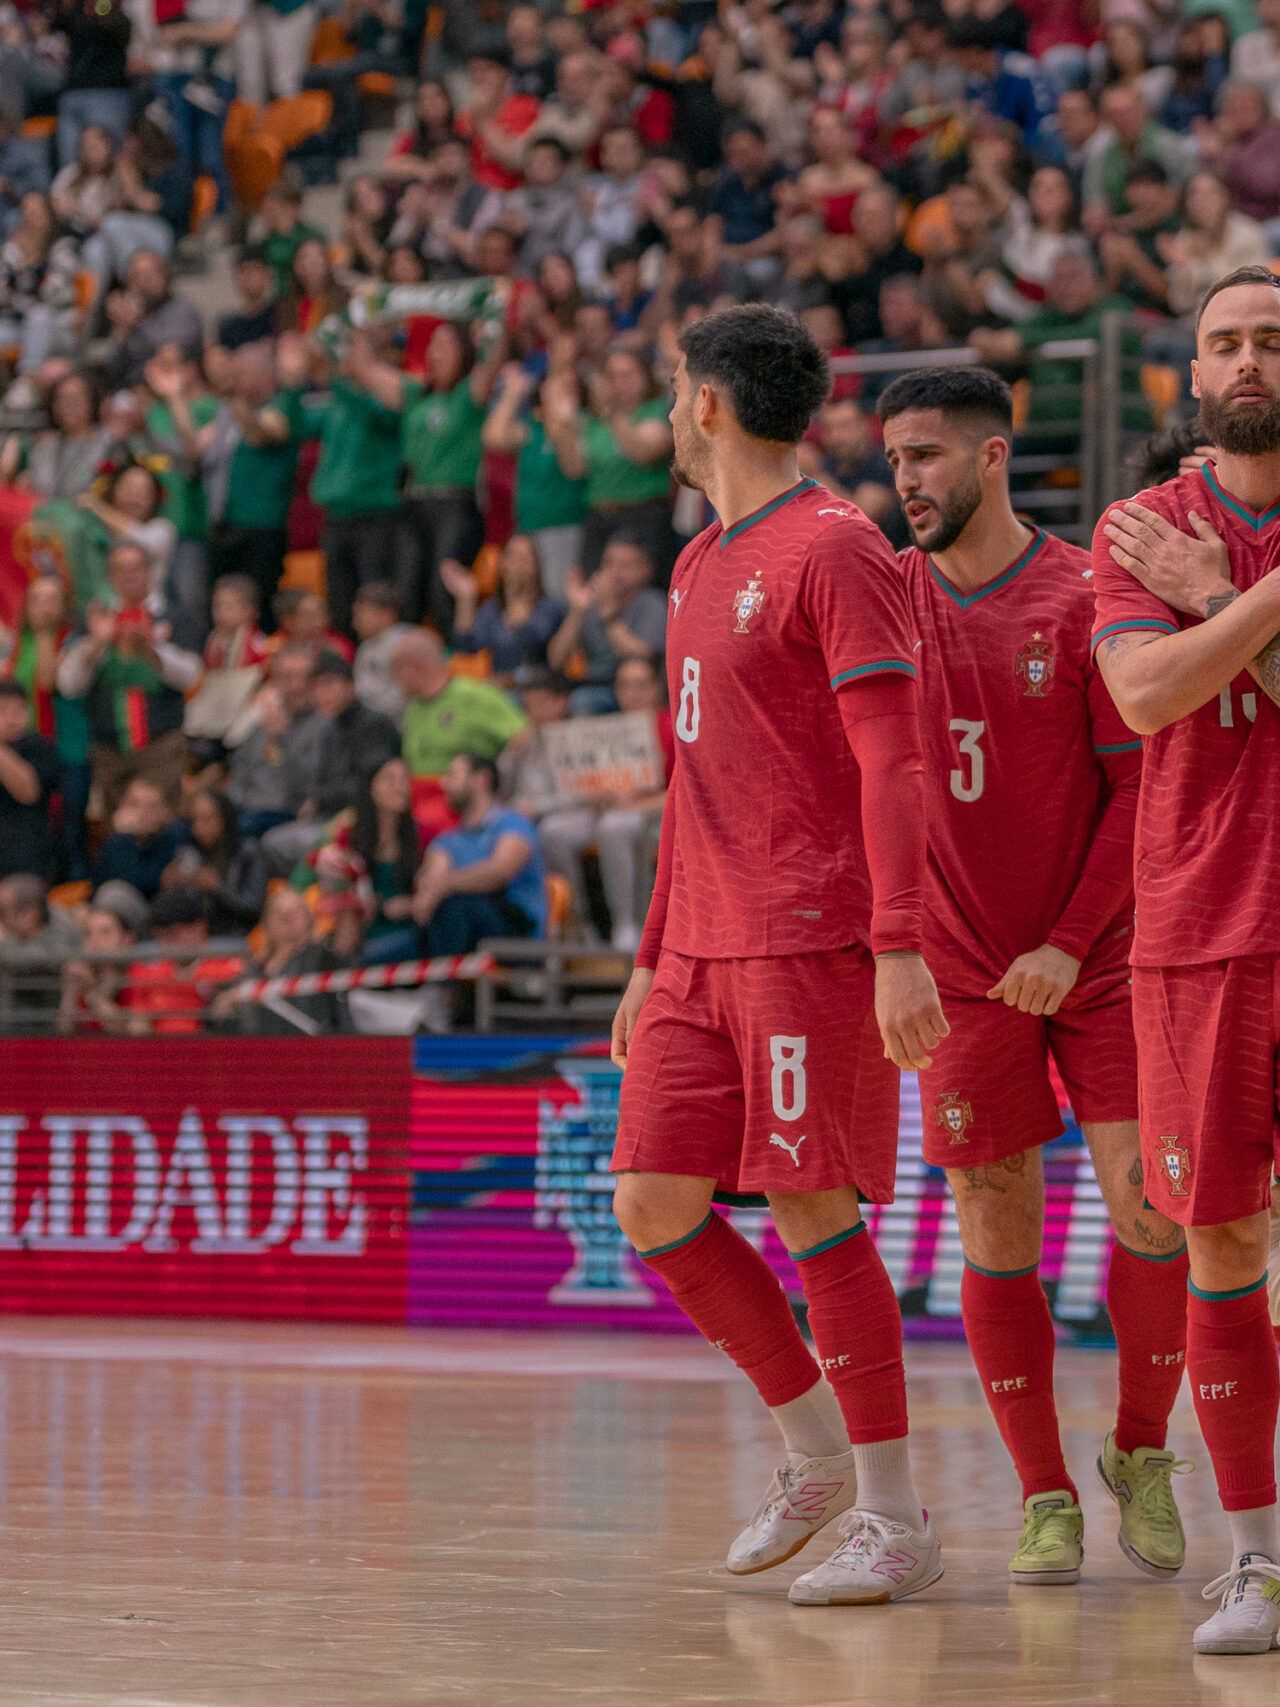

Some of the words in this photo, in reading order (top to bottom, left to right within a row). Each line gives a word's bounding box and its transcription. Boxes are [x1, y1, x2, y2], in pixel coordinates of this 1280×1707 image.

[675, 656, 699, 743] 8
[949, 718, 985, 803] 3
[770, 1034, 806, 1122] 8
[0, 1106, 368, 1256] LIDADE
